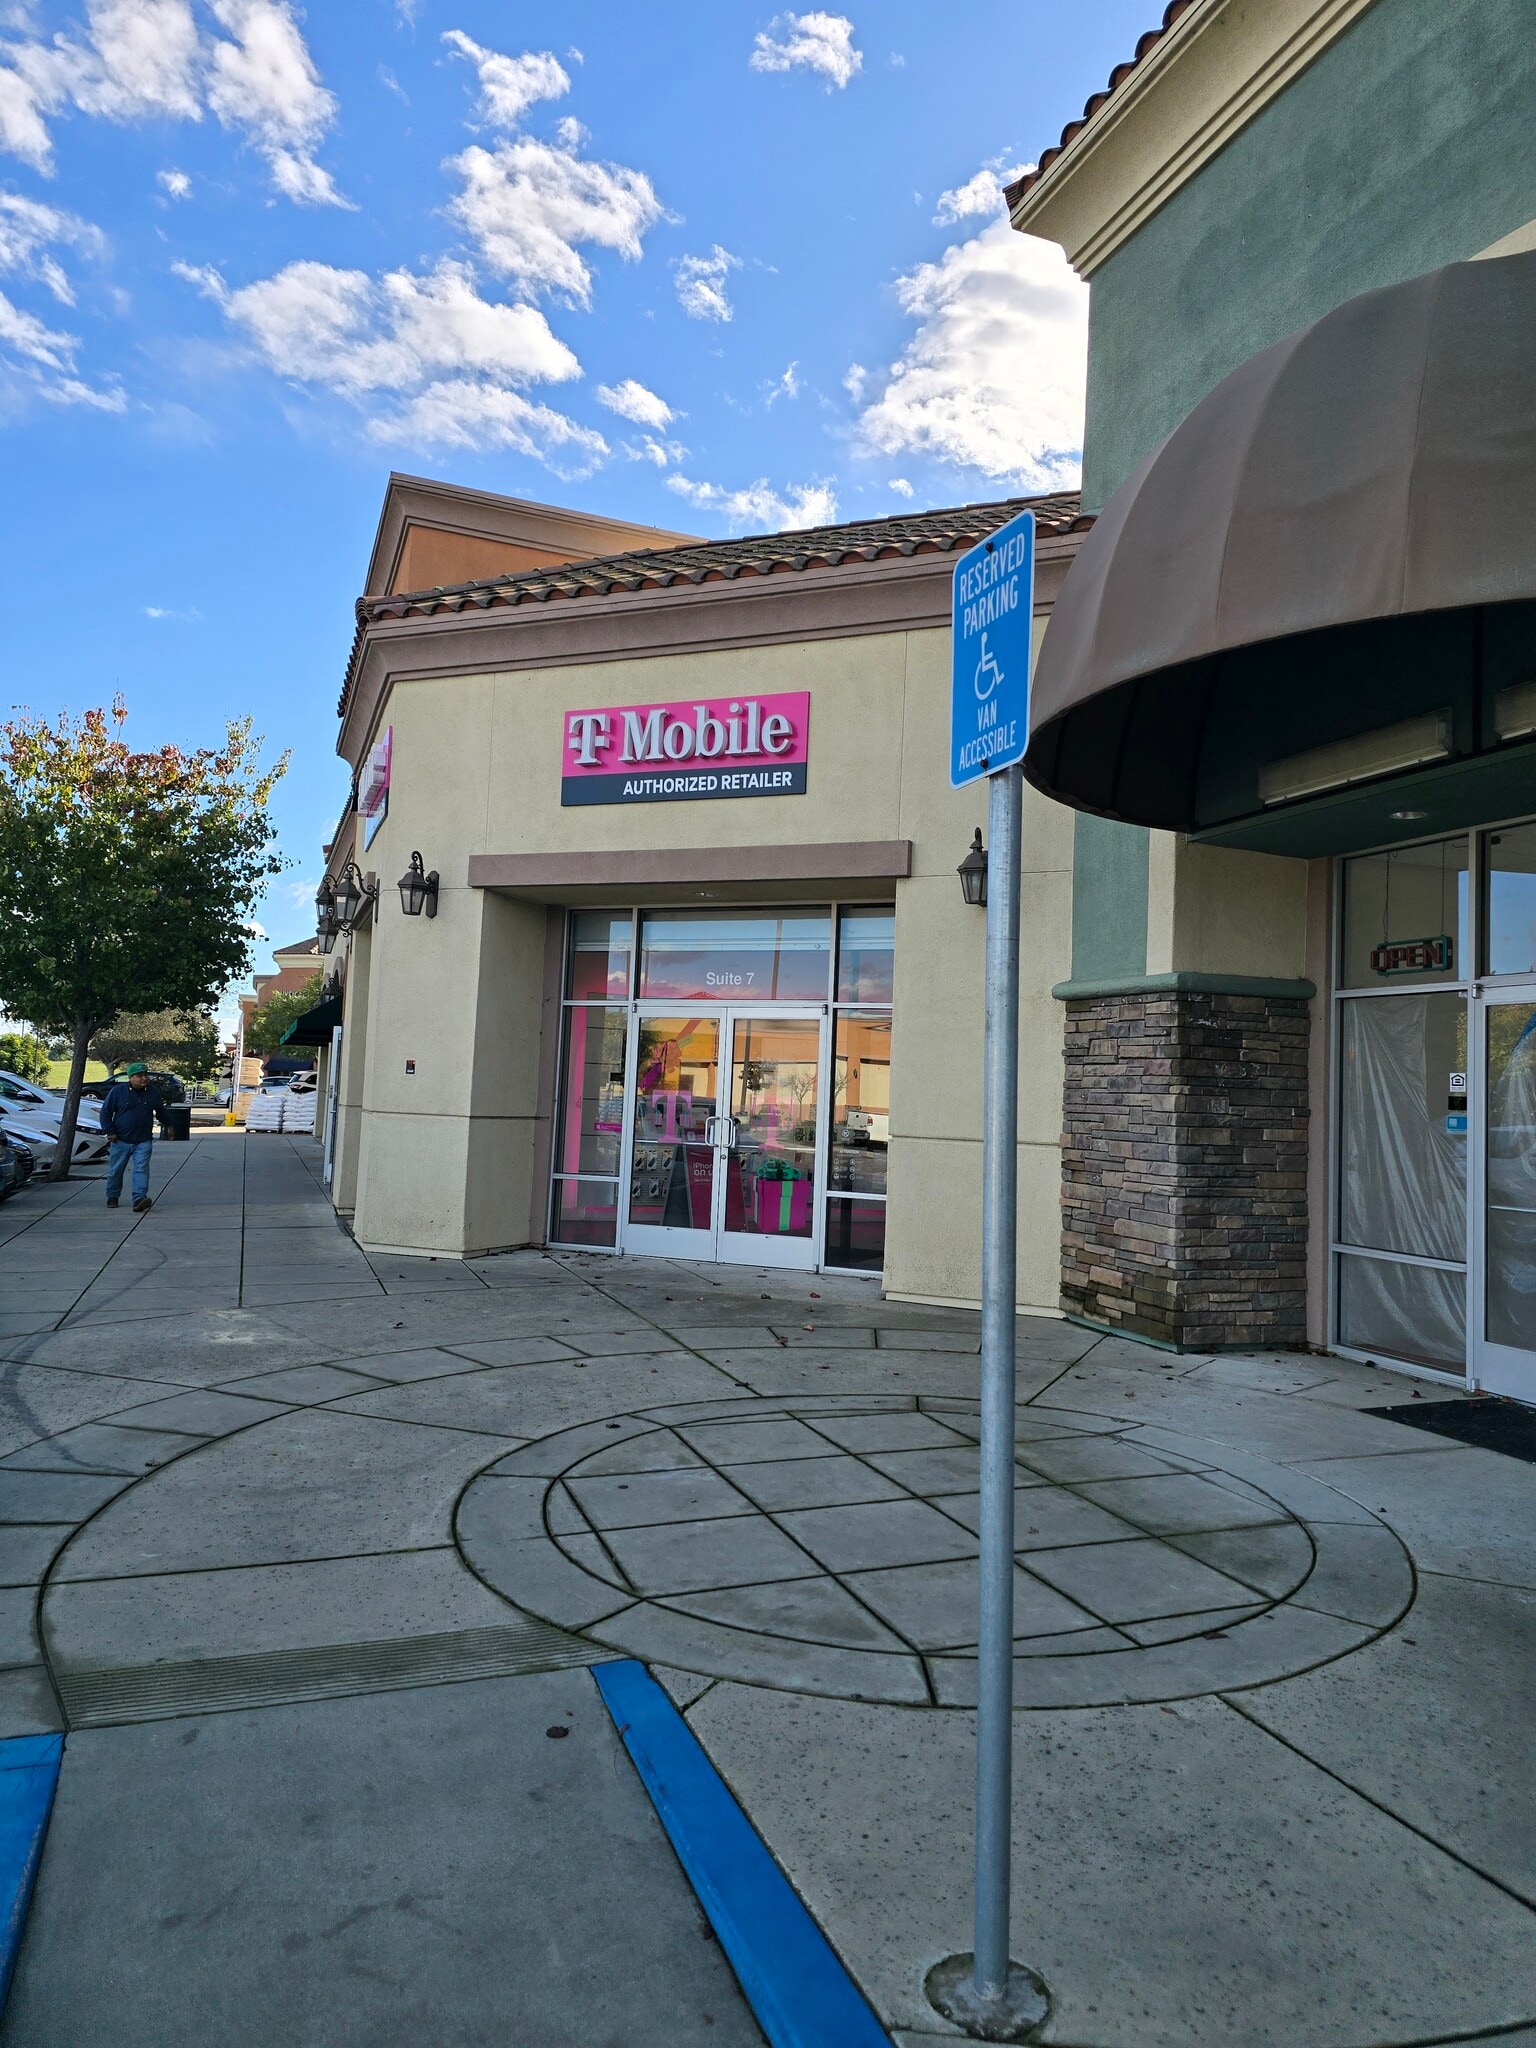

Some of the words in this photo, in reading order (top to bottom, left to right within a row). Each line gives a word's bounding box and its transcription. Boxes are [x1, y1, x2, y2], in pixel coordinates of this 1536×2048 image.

[960, 532, 1025, 605] RESERVED
[963, 574, 1019, 639] PARKING
[568, 713, 611, 766] T
[618, 700, 794, 761] Mobile
[977, 699, 997, 732] VAN
[958, 720, 1017, 772] ACCESSIBLE
[622, 776, 718, 796] AUTHORIZED
[721, 771, 793, 790] RETAILER
[1370, 942, 1444, 971] OPEN
[705, 971, 742, 985] Suite
[746, 972, 755, 985] 7
